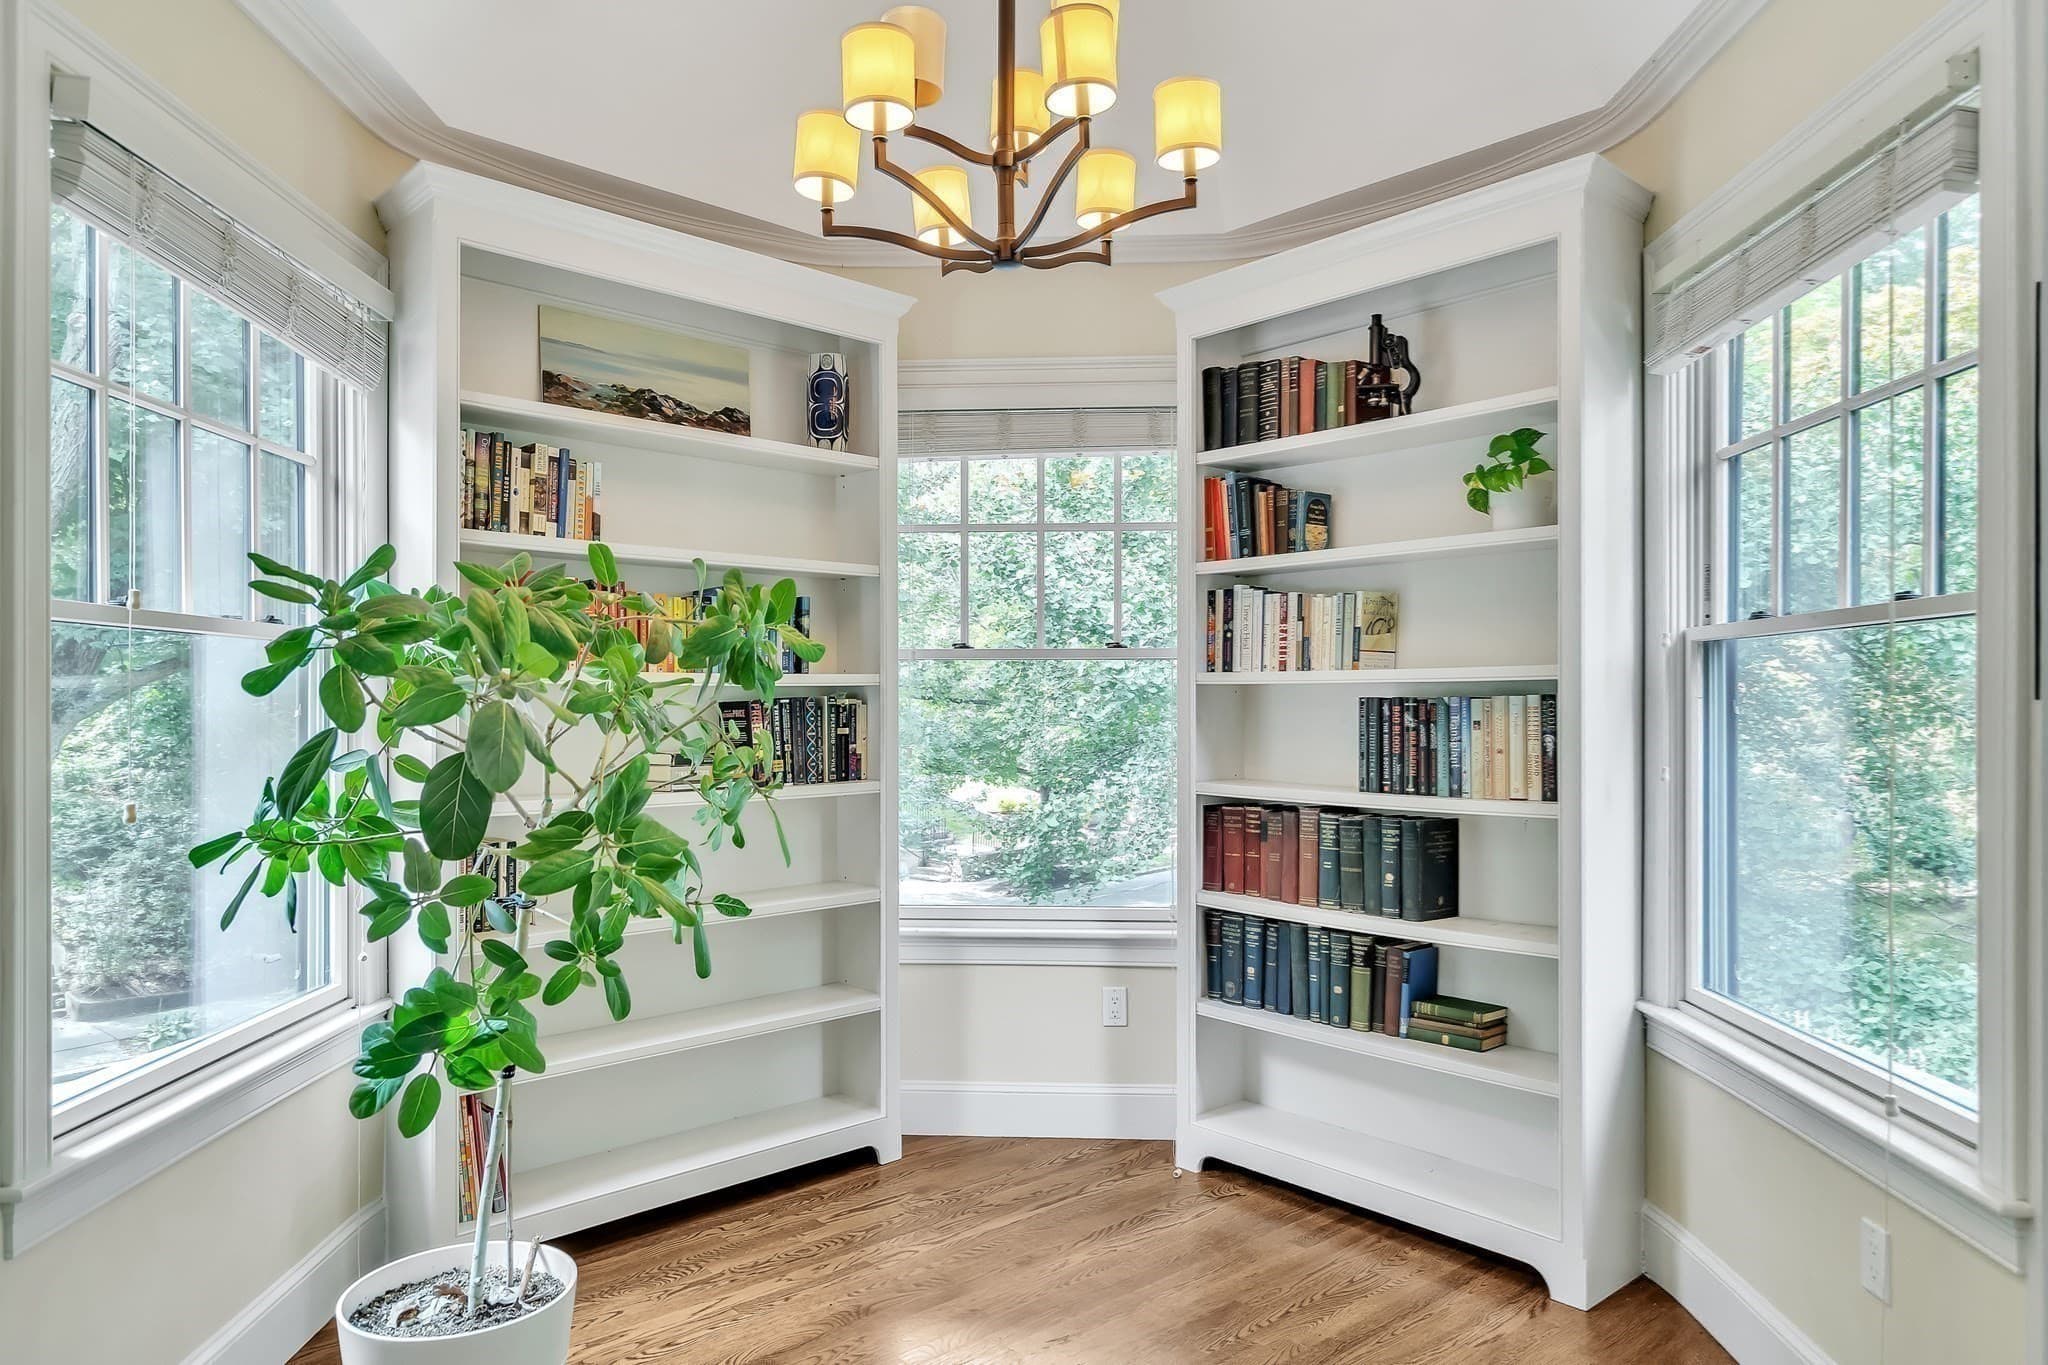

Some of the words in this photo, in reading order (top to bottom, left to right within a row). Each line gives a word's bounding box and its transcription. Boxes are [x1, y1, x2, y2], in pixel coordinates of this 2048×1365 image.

[1392, 706, 1401, 723] BAD
[1392, 725, 1401, 754] BLOOD
[1450, 713, 1460, 768] Transplant
